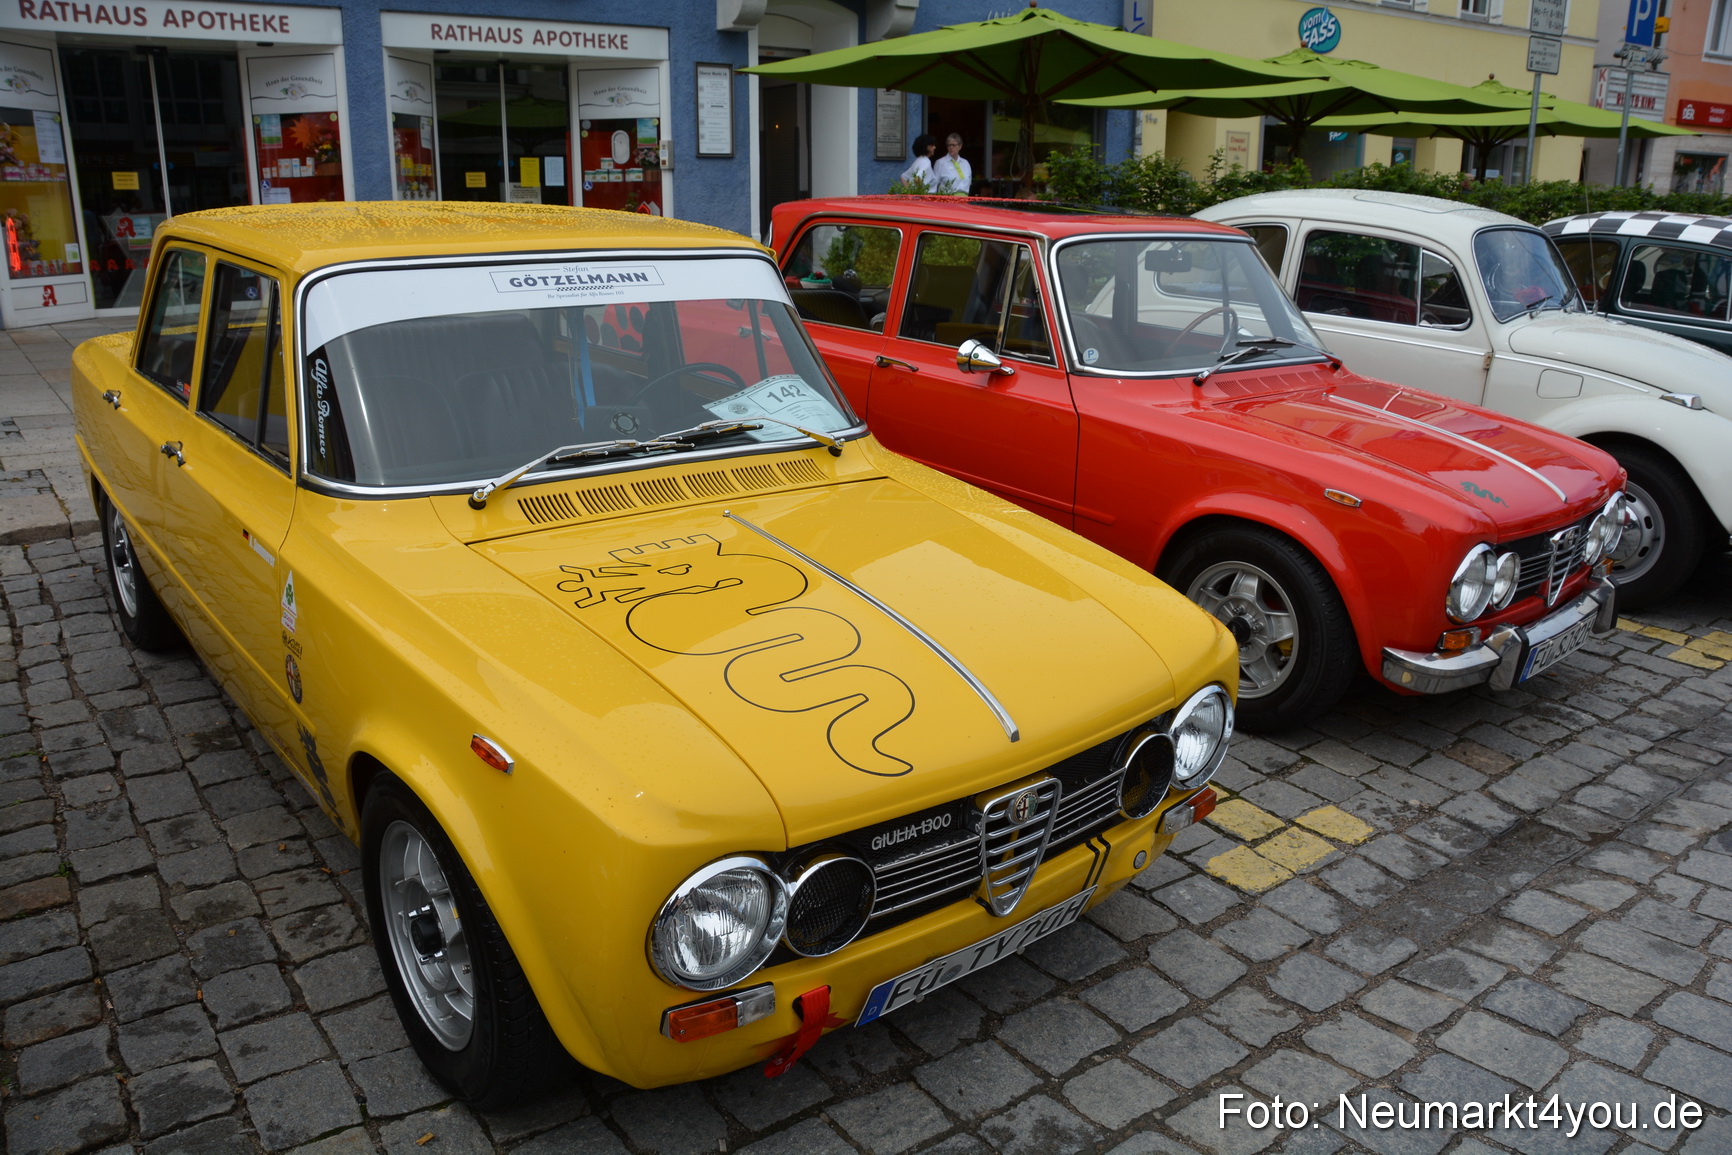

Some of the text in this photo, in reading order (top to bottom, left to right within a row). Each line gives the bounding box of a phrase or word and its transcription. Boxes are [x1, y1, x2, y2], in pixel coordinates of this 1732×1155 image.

[18, 0, 291, 34] RATHAUS APOTHEKE
[1303, 12, 1321, 30] vom
[1632, 0, 1652, 37] P
[430, 23, 630, 51] RATHAUS APOTHEKE
[1302, 16, 1336, 49] FASS
[265, 79, 281, 88] Haus
[290, 75, 323, 86] Gesundheit
[509, 272, 649, 288] GÖTZELMANN
[562, 264, 589, 274] Stefan
[766, 384, 808, 404] 142
[311, 358, 331, 459] Alfa Romeo
[885, 960, 947, 1012] FÜ
